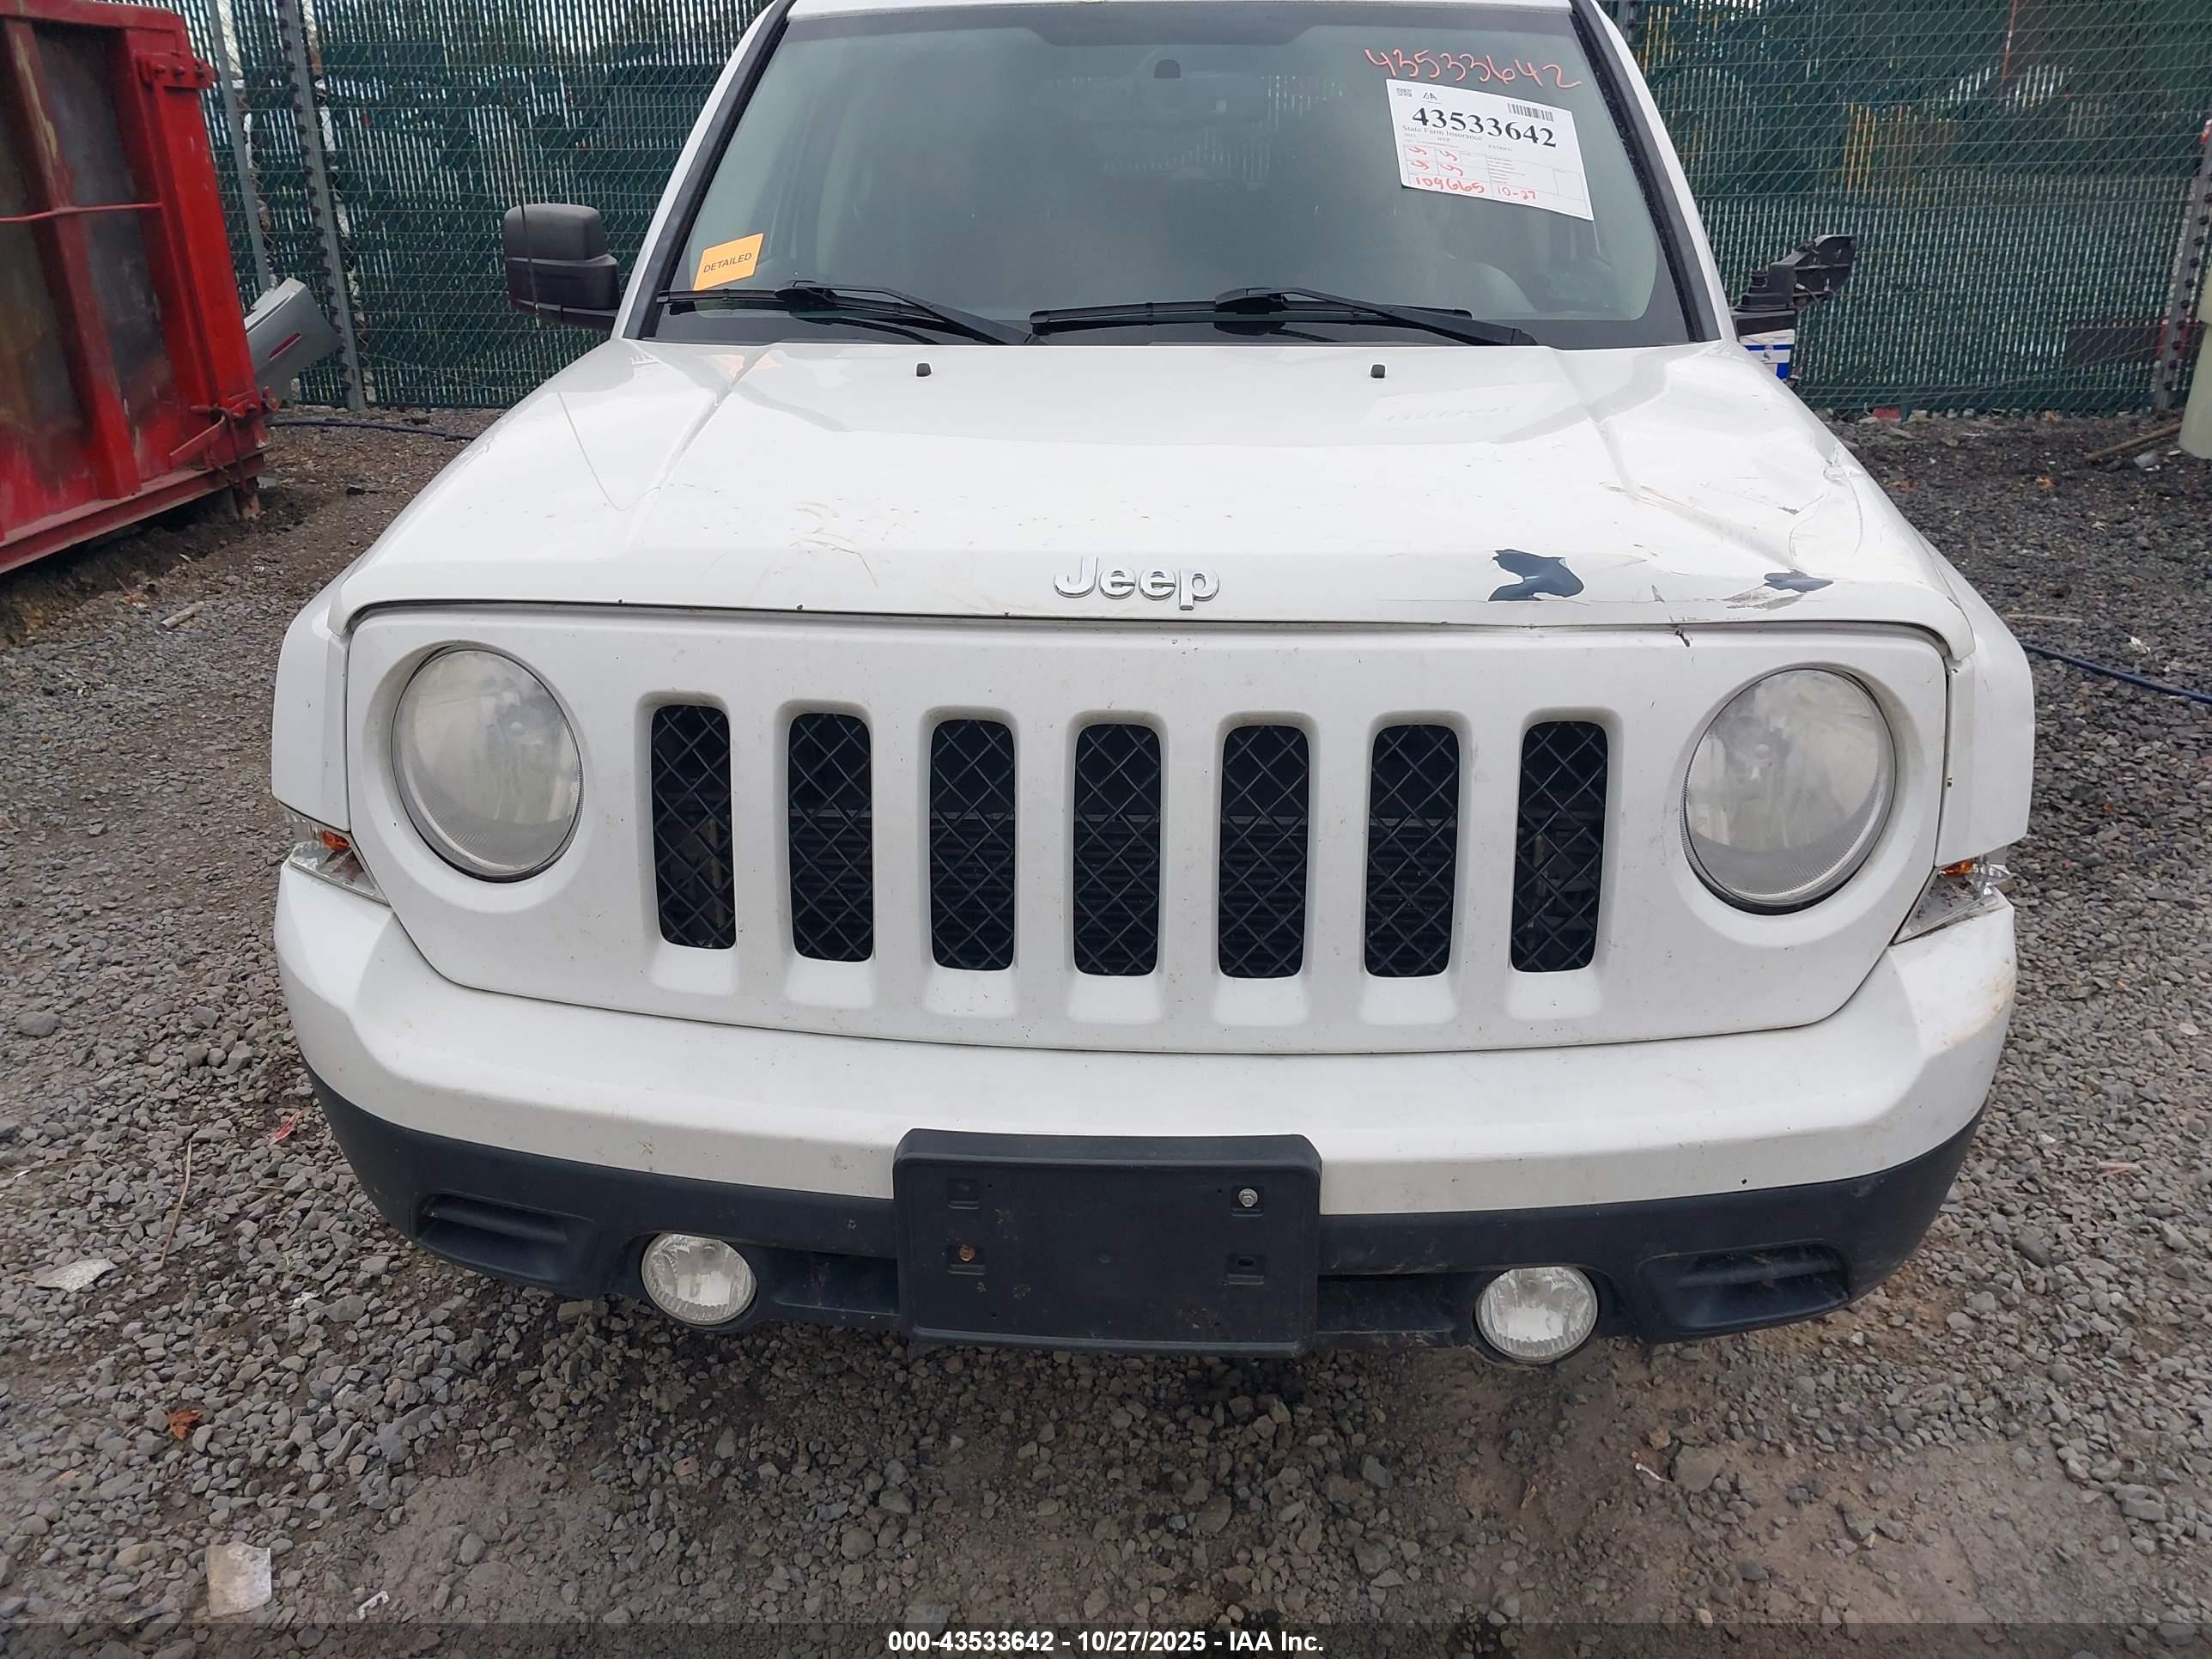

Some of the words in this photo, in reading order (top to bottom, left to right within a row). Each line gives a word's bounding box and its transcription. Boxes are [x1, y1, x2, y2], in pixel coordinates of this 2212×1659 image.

[1364, 48, 1582, 88] 43533642
[1412, 106, 1557, 148] 43533642
[1424, 127, 1443, 136] Farm
[1446, 130, 1482, 141] Insurance
[703, 252, 752, 273] DETAILED
[1054, 556, 1219, 611] Jeep
